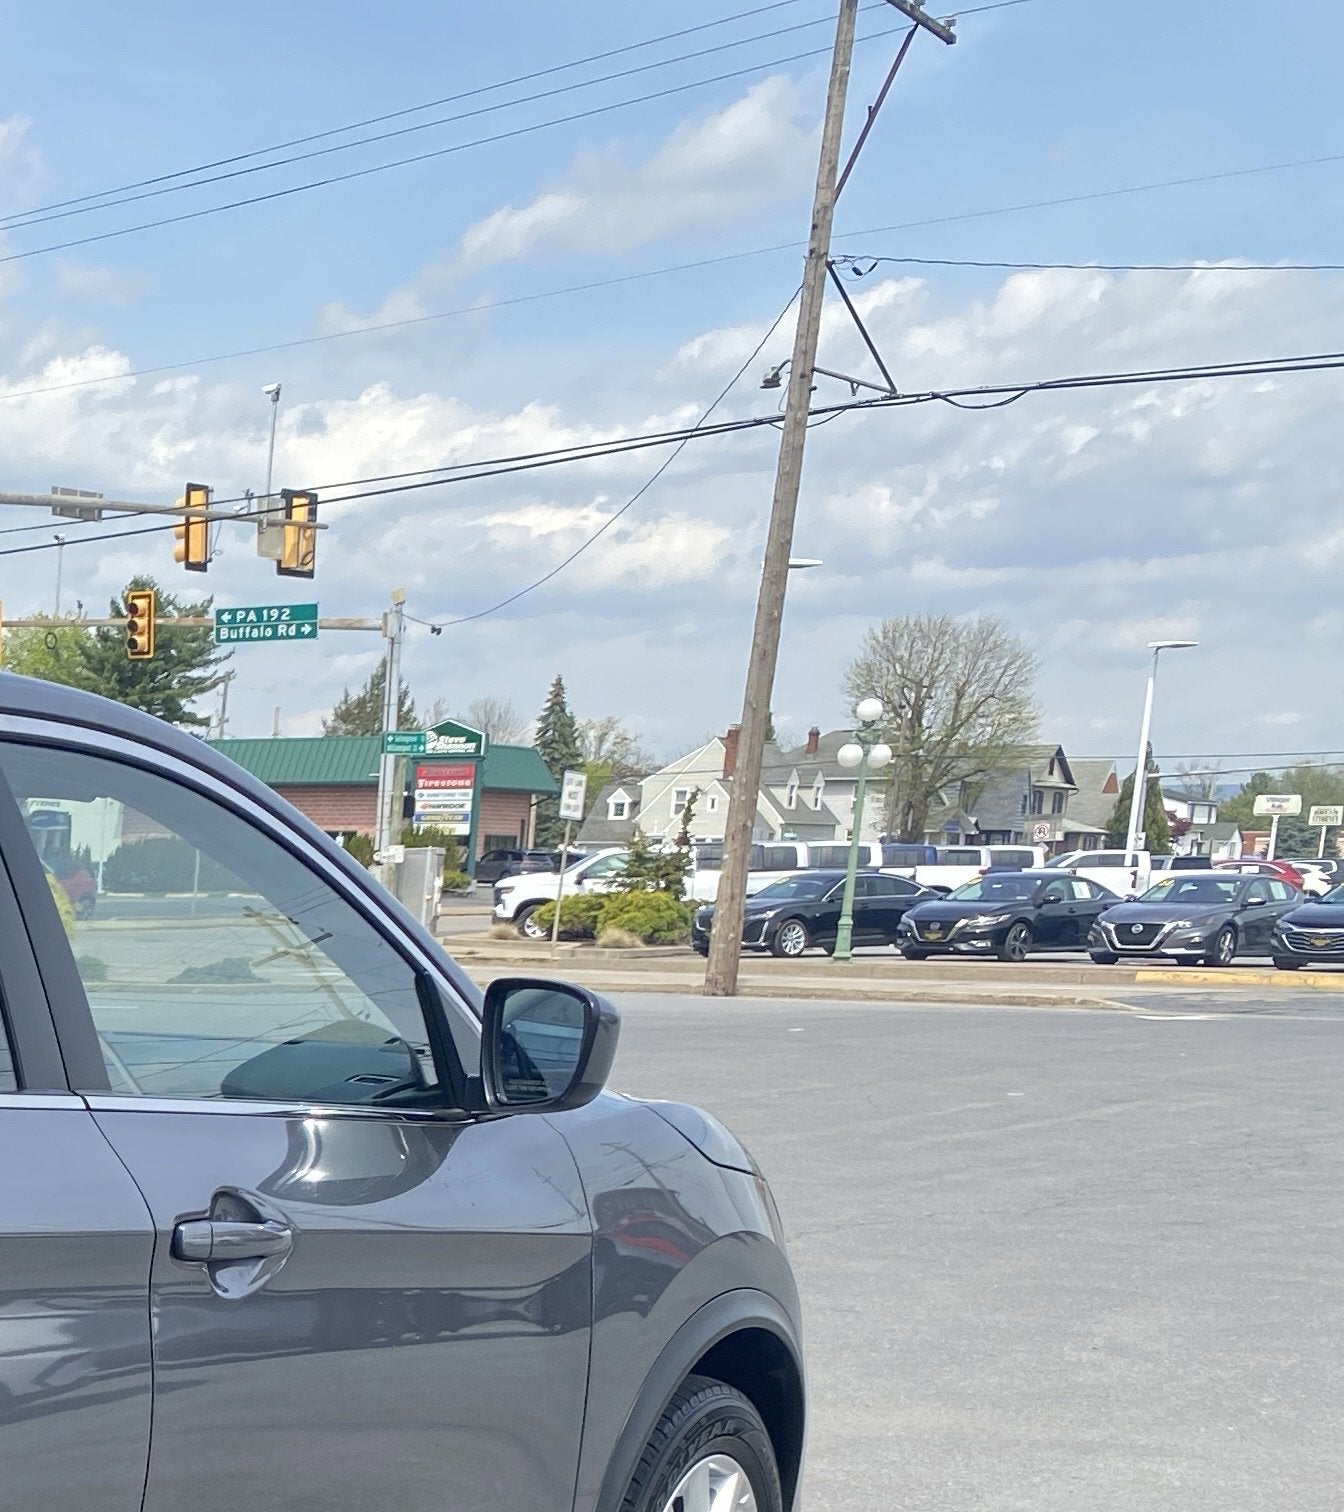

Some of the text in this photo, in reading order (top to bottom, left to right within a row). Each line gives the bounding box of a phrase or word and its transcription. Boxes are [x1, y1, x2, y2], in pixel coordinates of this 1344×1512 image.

[236, 607, 291, 622] PA 192
[219, 623, 296, 640] Buffalo Rd
